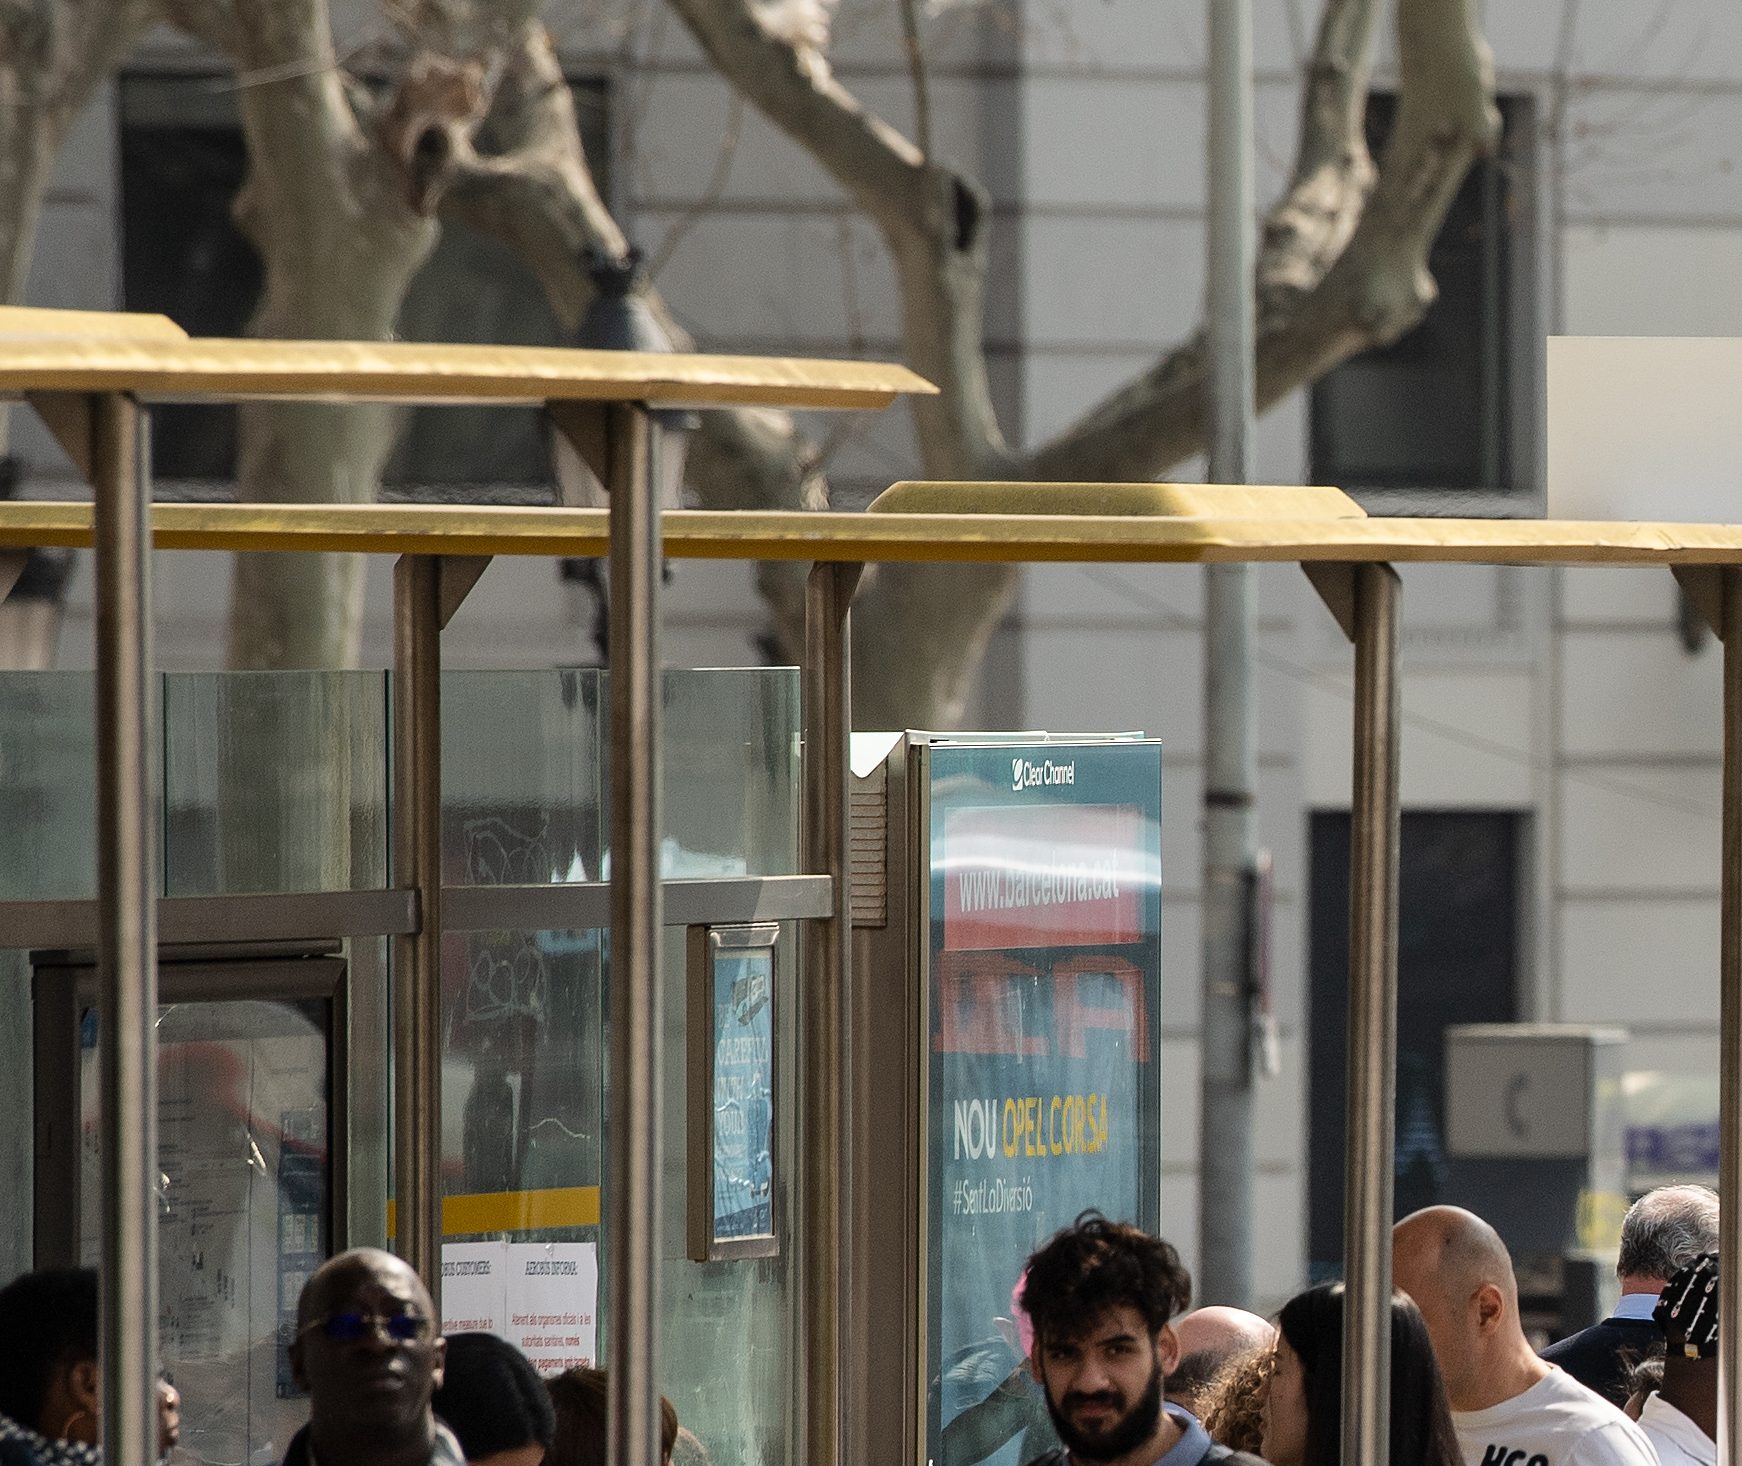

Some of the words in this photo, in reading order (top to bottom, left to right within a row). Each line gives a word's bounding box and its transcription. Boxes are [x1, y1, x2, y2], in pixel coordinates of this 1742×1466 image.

[1023, 760, 1044, 787] Clear
[1044, 759, 1075, 785] Channel
[959, 847, 1120, 912] www.barcelona.cat
[953, 1098, 998, 1161] NOU
[1002, 1096, 1049, 1158] OPEL
[1049, 1092, 1109, 1157] CORSA
[952, 1174, 1034, 1215] #SentLaDiversió
